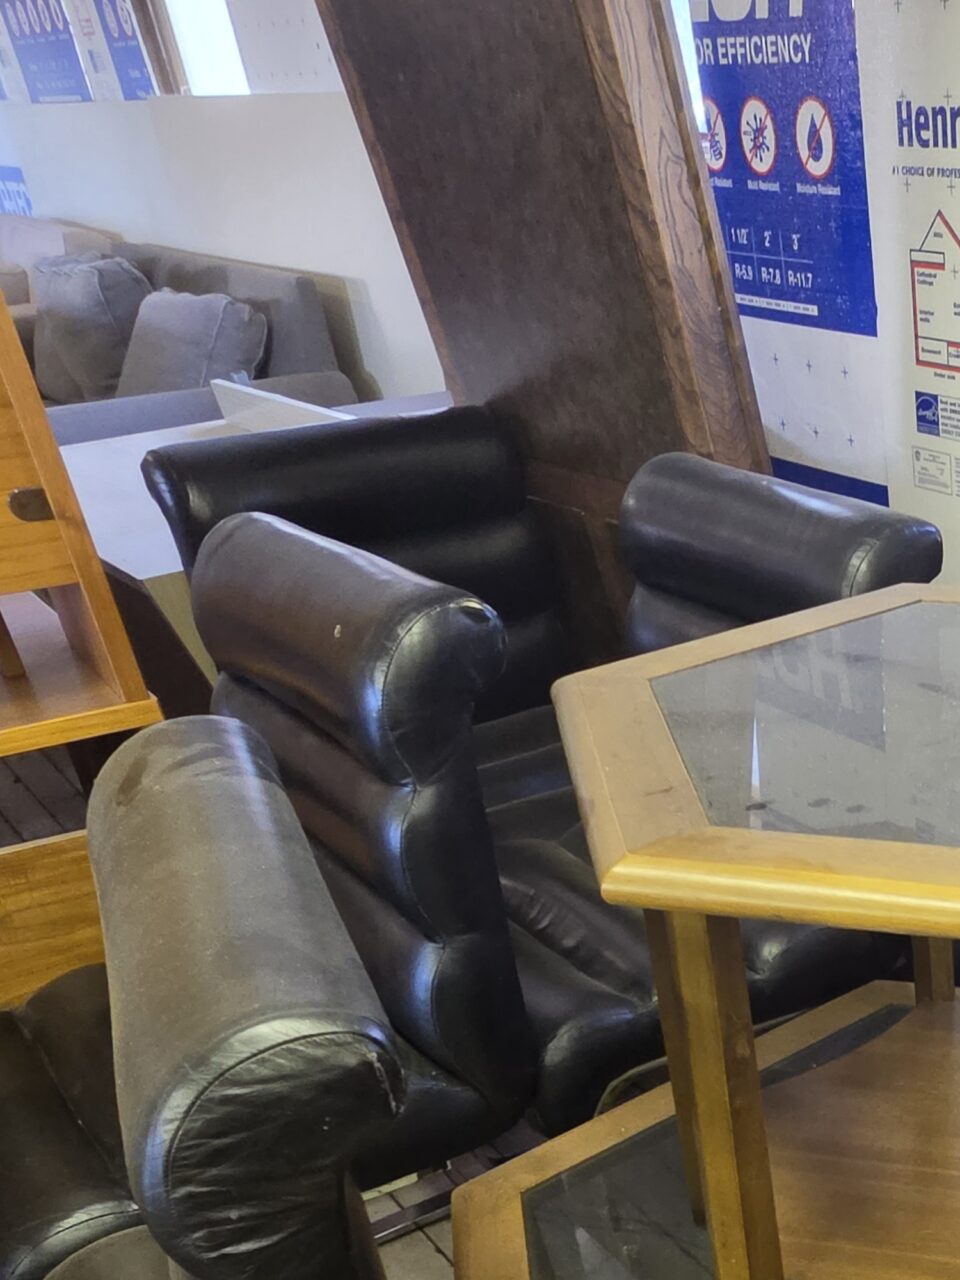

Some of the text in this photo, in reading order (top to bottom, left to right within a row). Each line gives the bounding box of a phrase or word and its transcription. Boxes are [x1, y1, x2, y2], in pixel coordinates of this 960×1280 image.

[717, 32, 811, 65] EFFICIENCY
[902, 166, 925, 177] CHOICE
[926, 167, 936, 178] OF
[787, 270, 813, 289] R-11.7
